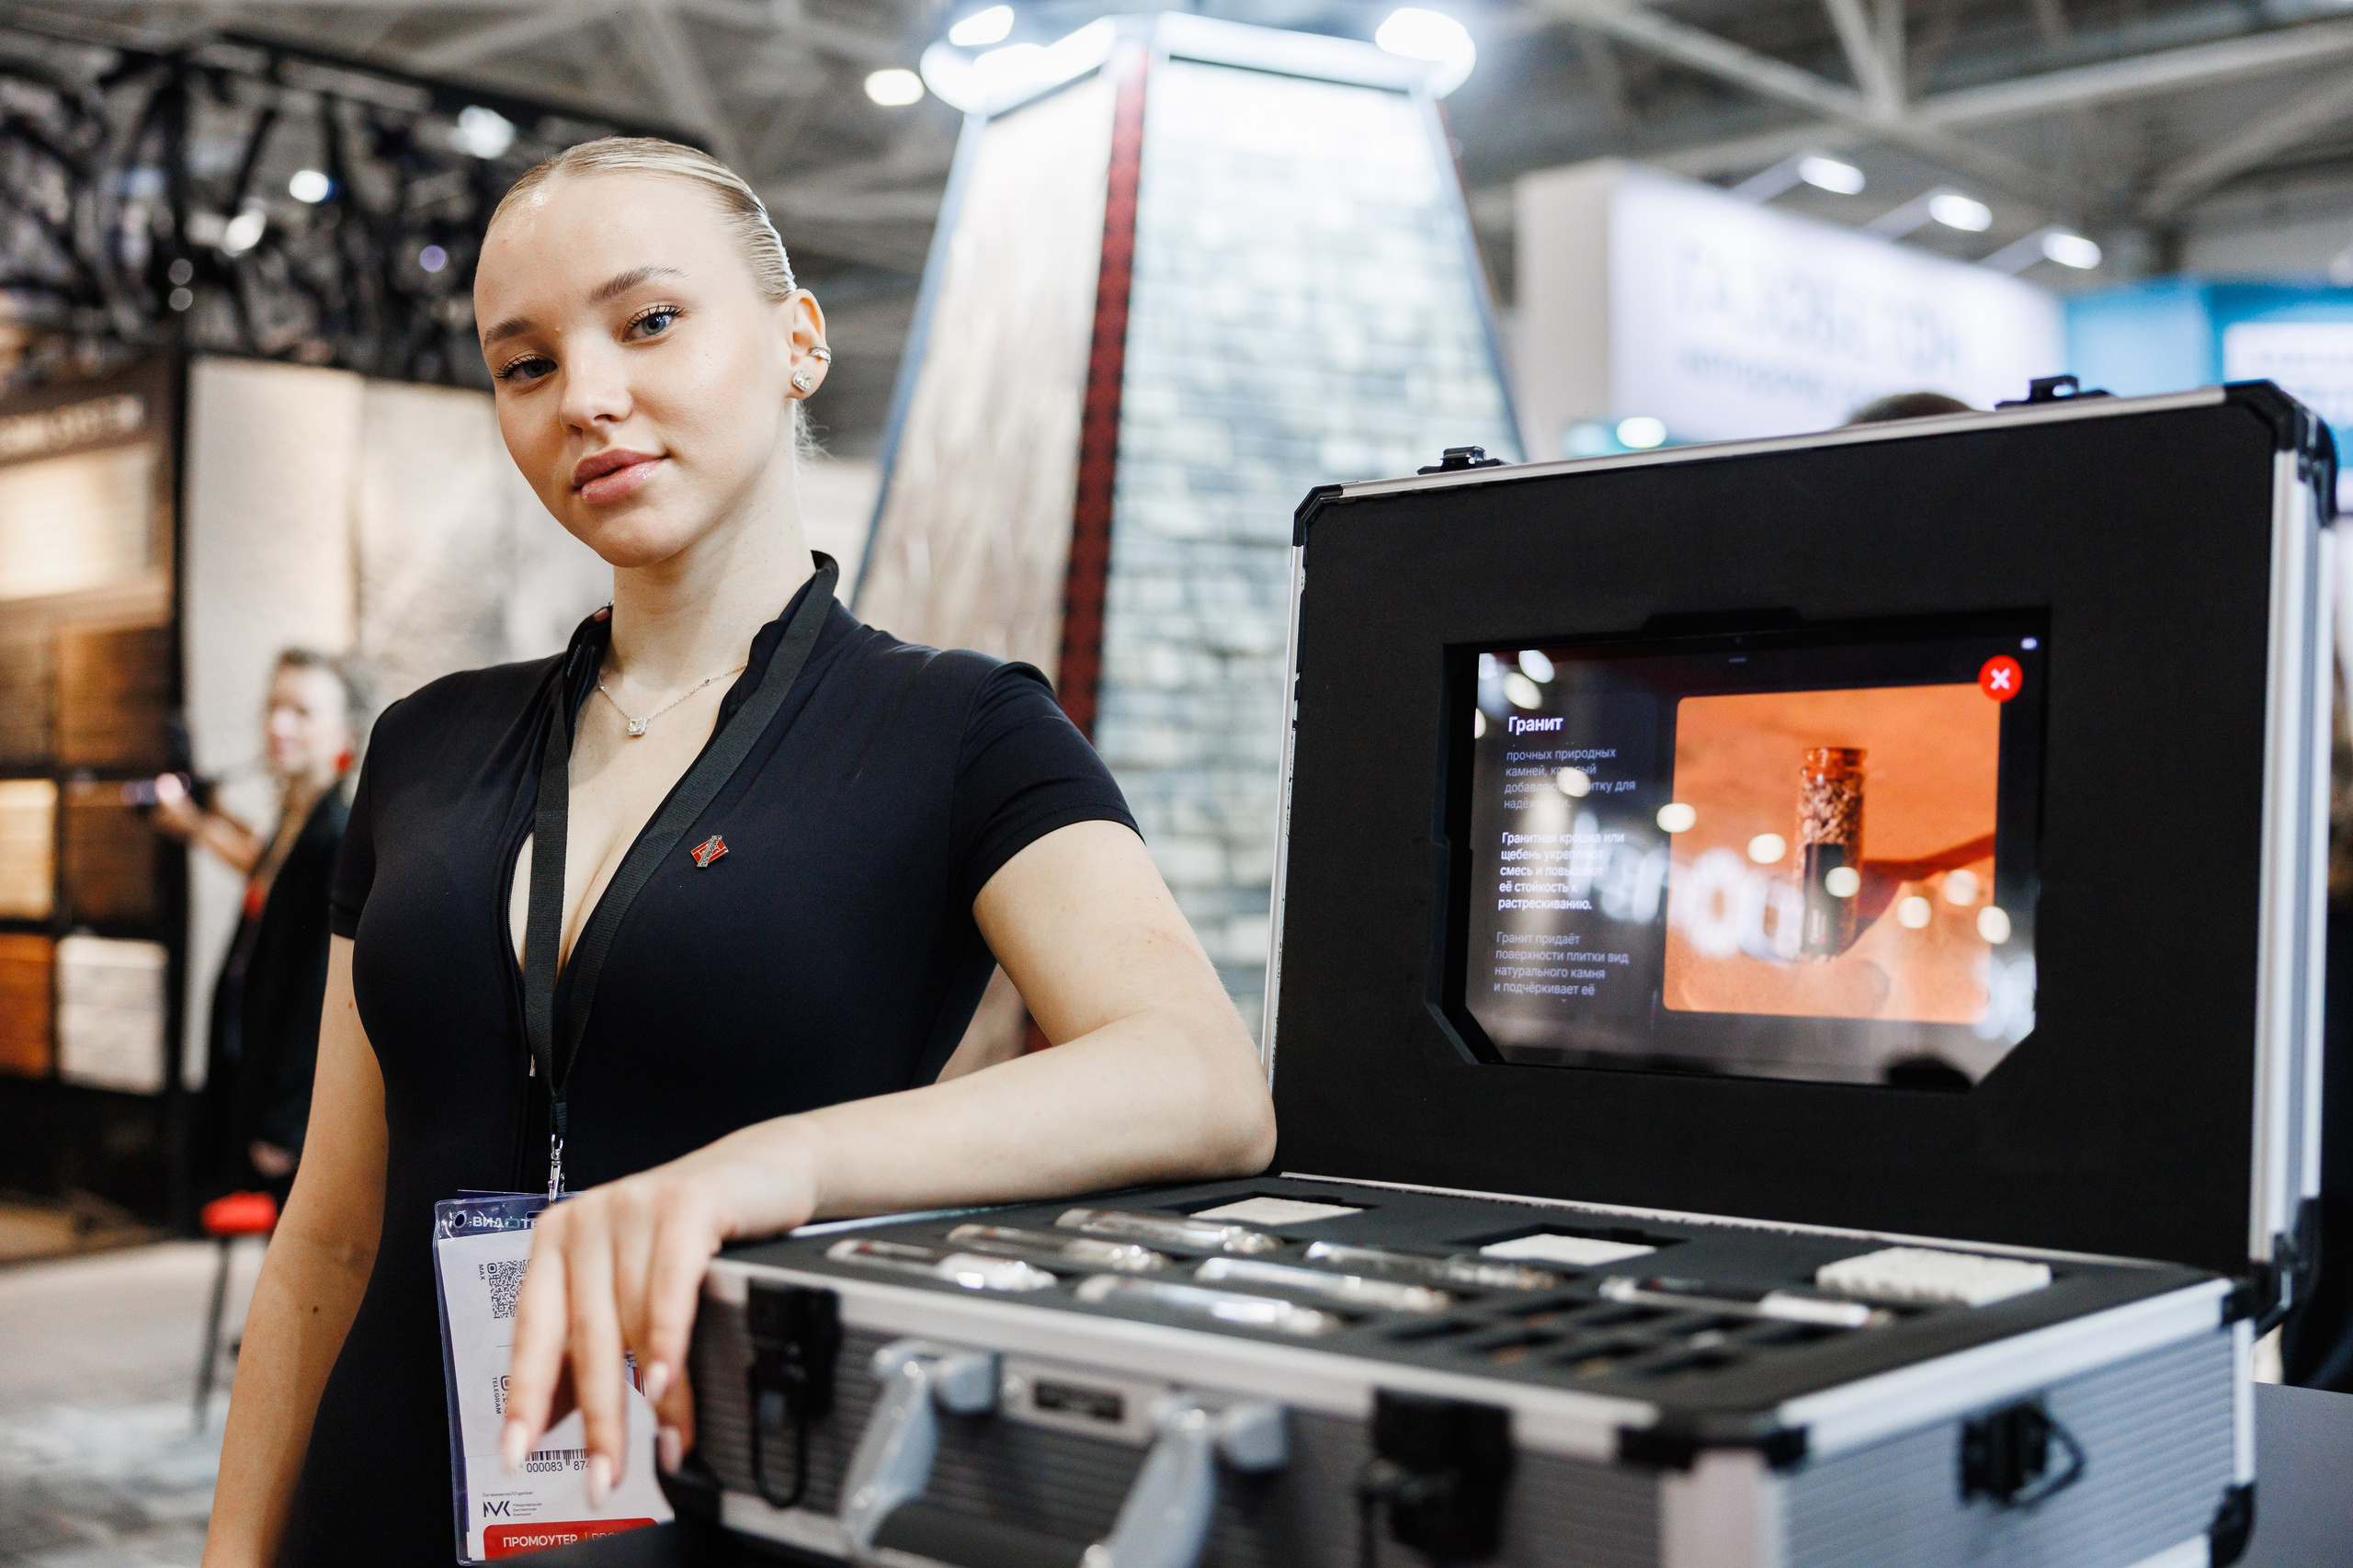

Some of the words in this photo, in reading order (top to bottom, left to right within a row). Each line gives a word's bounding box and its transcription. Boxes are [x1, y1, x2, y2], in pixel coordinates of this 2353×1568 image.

[1508, 716, 1563, 735] Гранит
[1506, 750, 1552, 762] прочных
[1554, 748, 1616, 761] природных
[1506, 765, 1547, 777] камней,
[1615, 780, 1636, 792] для
[1501, 832, 1557, 846] Гранитная
[1560, 833, 1601, 846] крошка
[1604, 833, 1625, 843] или
[1500, 848, 1540, 861] щебень
[1500, 867, 1532, 876] смесь
[1536, 867, 1542, 876] и
[1499, 881, 1512, 892] её
[1514, 881, 1568, 892] стойкость
[1571, 883, 1578, 892] к
[1498, 898, 1592, 911] растрескиванию.
[1496, 931, 1532, 945] Гранит
[1535, 932, 1580, 946] придаёт
[1495, 949, 1563, 961] поверхности
[1566, 952, 1605, 962] плитки
[1608, 953, 1629, 964] вид
[1495, 966, 1568, 979] натурального
[1571, 969, 1606, 979] камня
[1494, 983, 1500, 992] и
[1503, 982, 1579, 994] подчёркивает
[1581, 984, 1596, 996] её
[493, 1377, 502, 1415] TELEGRAM
[526, 1461, 563, 1472] 000083
[503, 1534, 577, 1548] ПРОМОУТЕР
